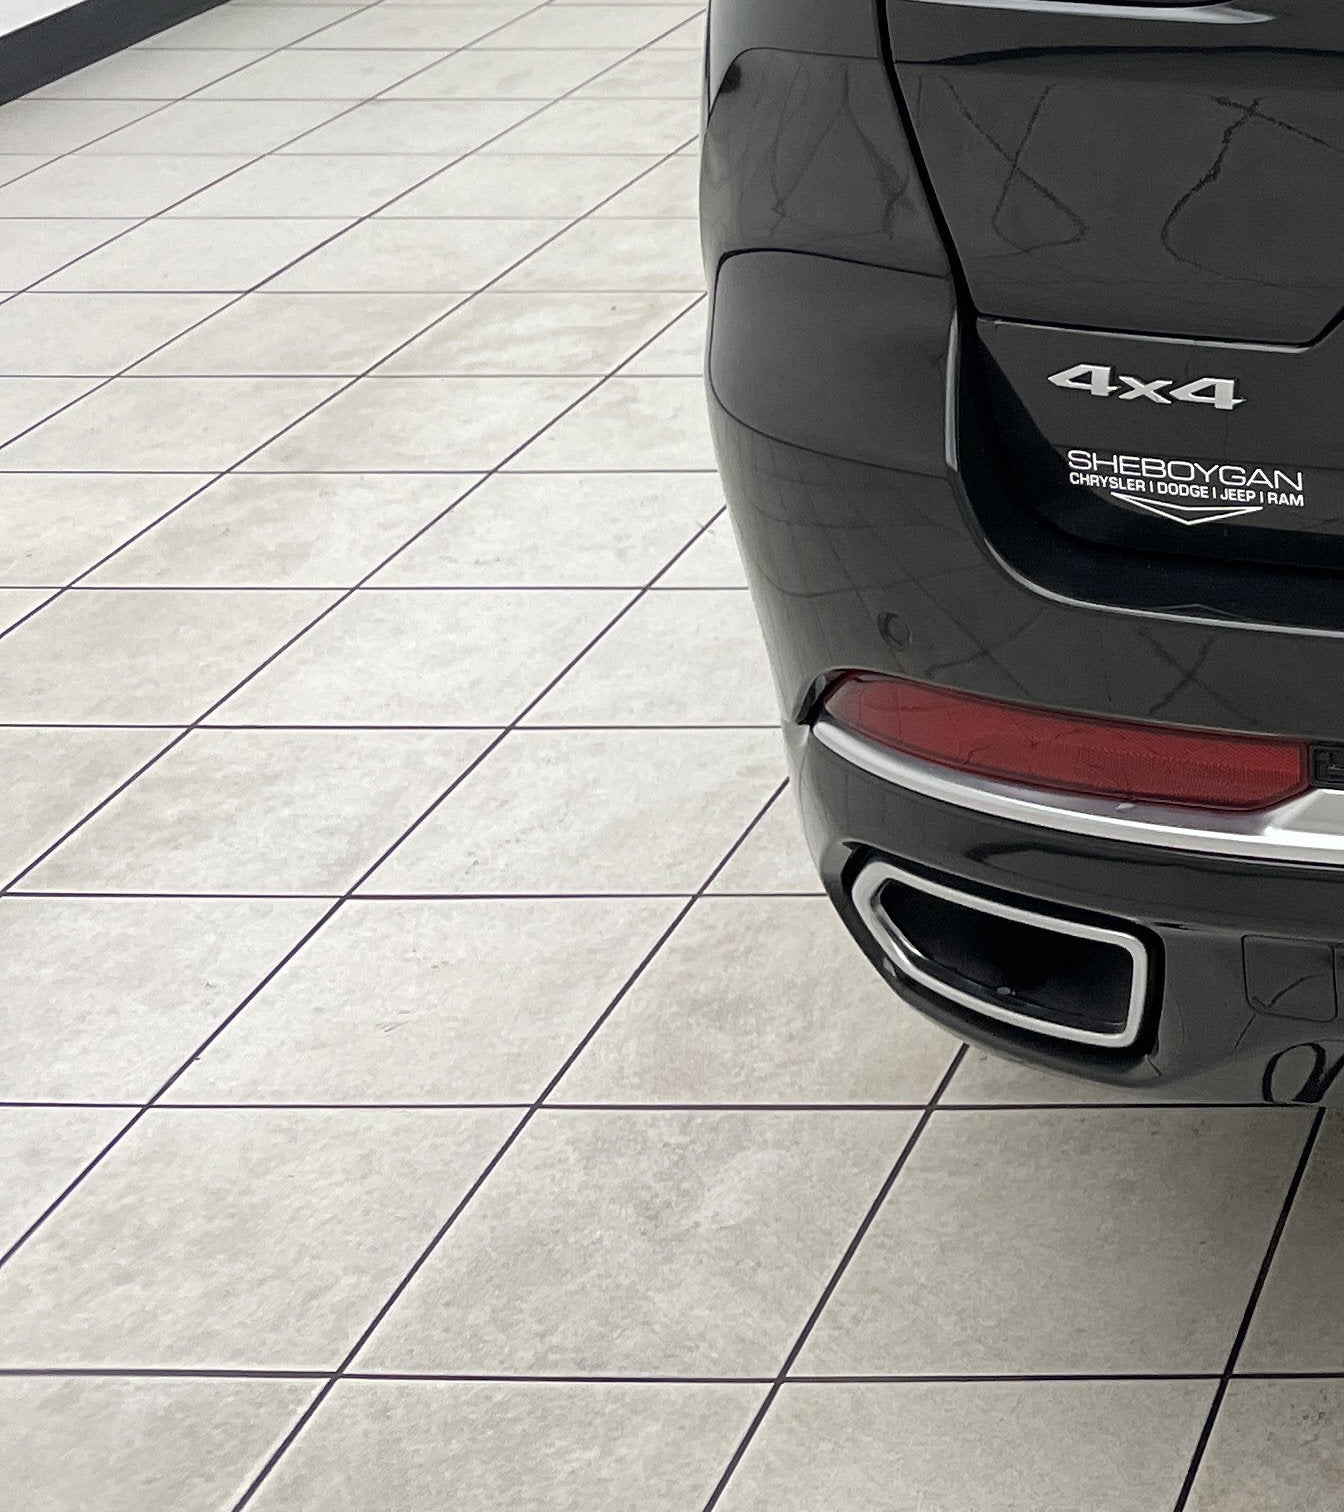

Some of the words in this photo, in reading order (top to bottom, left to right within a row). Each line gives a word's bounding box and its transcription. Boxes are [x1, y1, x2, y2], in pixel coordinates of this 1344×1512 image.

[1048, 364, 1247, 410] 4x4
[1067, 449, 1304, 491] SHEBOYGAN
[1069, 472, 1146, 493] CHRYSLER
[1157, 480, 1210, 499] DODGE
[1220, 488, 1256, 503] JEEP
[1268, 492, 1305, 507] RAM
